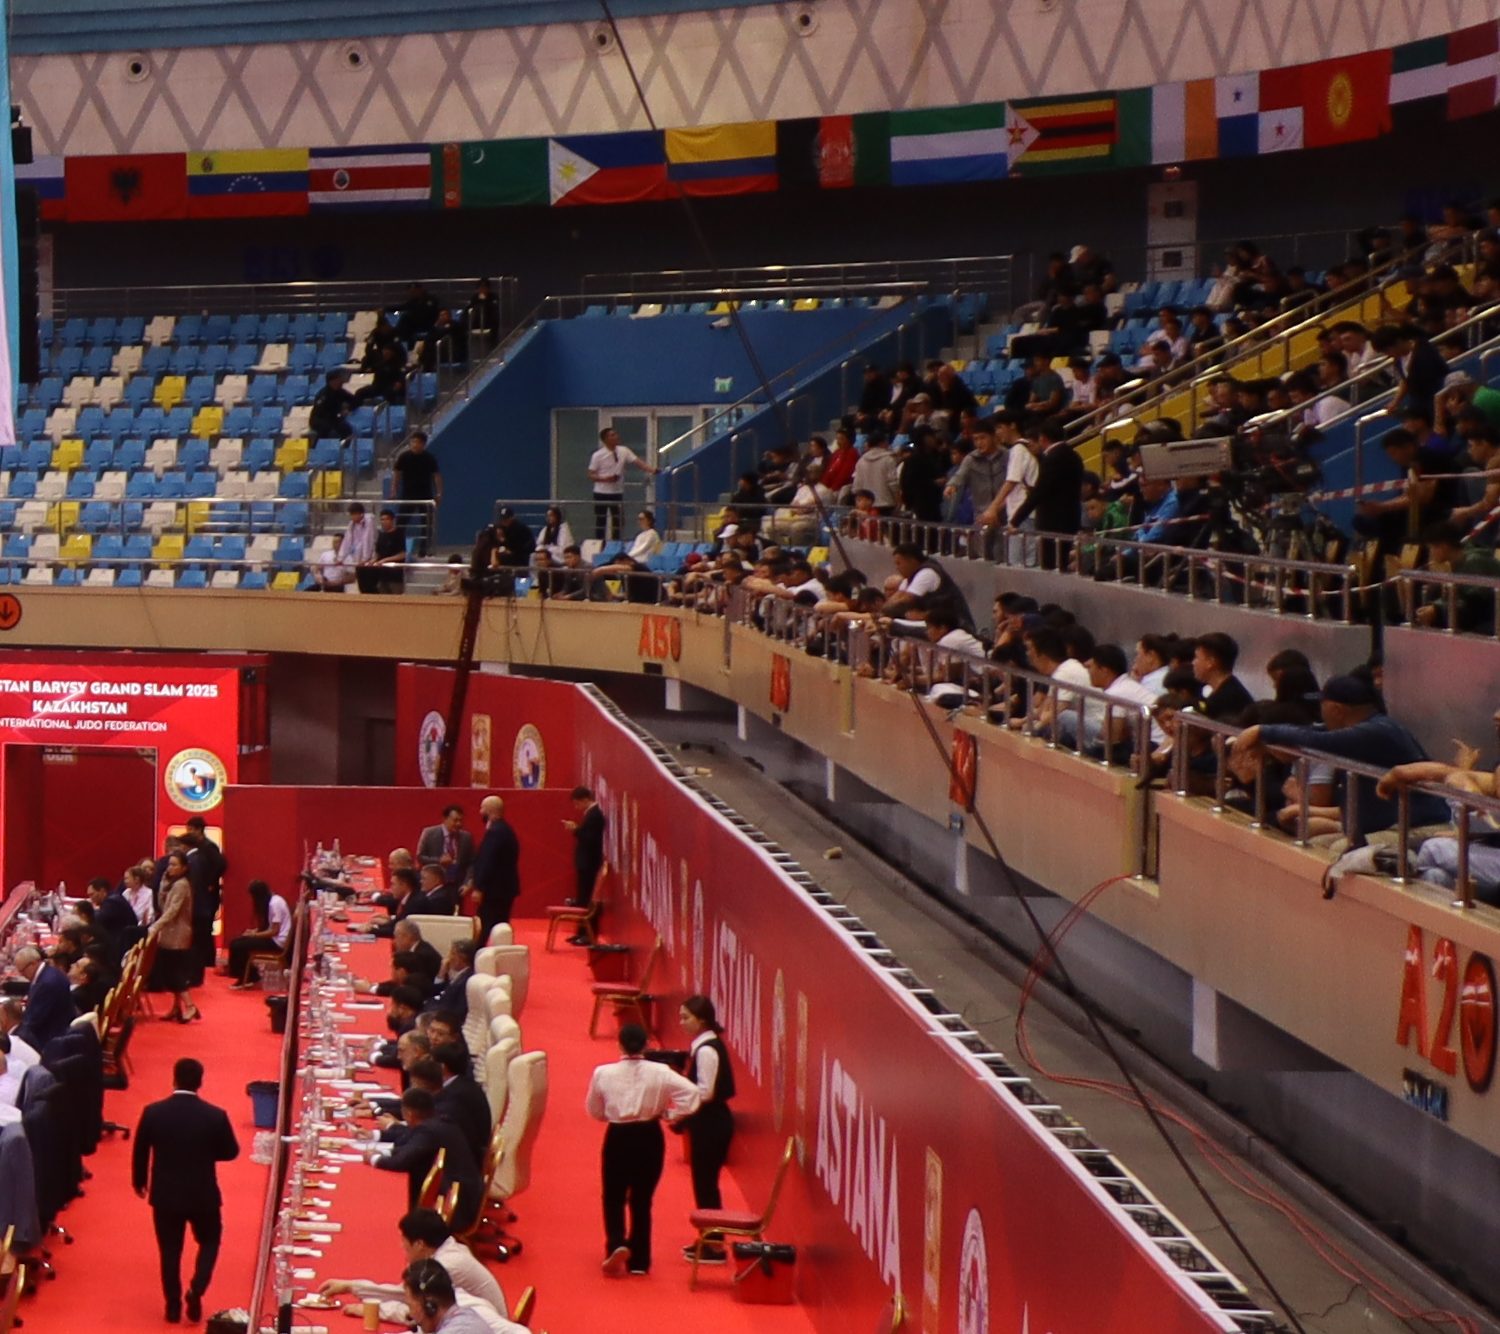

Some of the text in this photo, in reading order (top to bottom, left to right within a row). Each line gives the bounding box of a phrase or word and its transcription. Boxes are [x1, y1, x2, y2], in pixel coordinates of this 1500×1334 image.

[32, 681, 87, 694] BARYSY
[91, 682, 141, 695] GRAND
[144, 684, 183, 696] SLAM
[186, 685, 218, 697] 2025
[32, 700, 127, 715] KAZAKHSTAN
[74, 720, 102, 730] JUDO
[105, 720, 167, 732] FEDERATION
